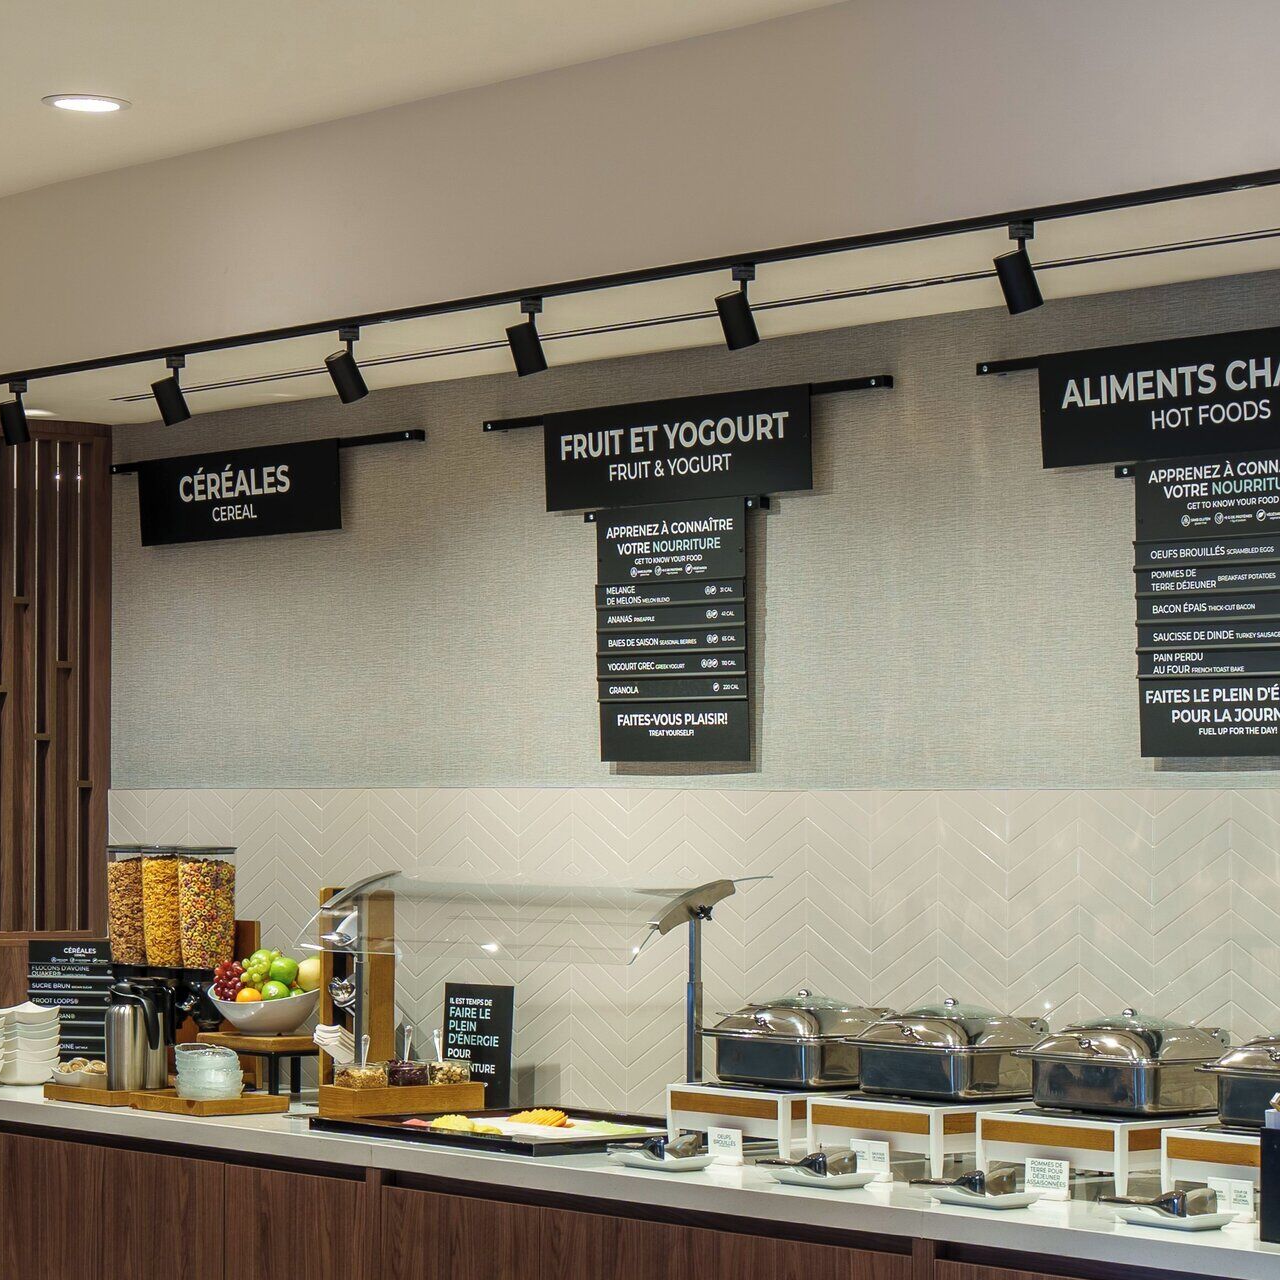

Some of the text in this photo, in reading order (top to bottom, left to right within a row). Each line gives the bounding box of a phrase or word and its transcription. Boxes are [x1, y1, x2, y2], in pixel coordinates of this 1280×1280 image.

[1061, 363, 1217, 409] ALIMENTS
[1151, 399, 1271, 430] HOT FOODS
[560, 411, 789, 461] FRUIT ET YOGOURT
[608, 453, 732, 482] FRUIT & YOGURT
[1148, 464, 1221, 484] APPRENEZ
[1223, 460, 1234, 477] À
[179, 464, 291, 502] CÉRÉALES
[1163, 482, 1208, 499] VOTRE
[1187, 495, 1279, 510] GET TO KNOW YOUR FOOD
[212, 504, 257, 522] CEREAL
[606, 516, 733, 539] APPRENEZ À CONNAÎTRE
[617, 537, 721, 556] VOTRE NOURRITURE
[1150, 545, 1274, 560] OEUFS BROUILLÉS SCRAMBLED EGGS
[653, 556, 670, 564] KNOW
[670, 555, 686, 563] YOUR
[686, 554, 702, 562] FOOD
[1151, 568, 1197, 579] POMMES DE
[1217, 572, 1276, 582] BREAKFAST POTATOES
[606, 585, 635, 595] MELANGE
[1151, 579, 1217, 592] TERRE DÉJEUNER
[606, 597, 616, 606] DE
[616, 595, 642, 605] MELONS
[1152, 601, 1255, 614] BACON ÉPAIS THICK-CUT BACON
[607, 615, 633, 624] ANANAS
[608, 639, 626, 648] BAIES
[626, 638, 636, 647] DE
[636, 637, 659, 647] SAISON
[1153, 631, 1193, 642] SAUCISSE
[1193, 631, 1205, 641] DE
[1207, 630, 1235, 640] DINDE
[1153, 652, 1203, 662] PAIN PERDU
[607, 662, 637, 671] YOGOURT
[637, 661, 655, 670] GREC
[1153, 665, 1166, 674] AU
[1166, 664, 1190, 674] FOUR
[608, 686, 639, 694] GRANOLA
[1145, 689, 1190, 704] FAITES
[1193, 689, 1209, 703] LE
[1213, 687, 1254, 702] PLEIN
[617, 712, 728, 726] FAITES-VOUS PLAISIR!
[1171, 709, 1211, 723] POUR
[1214, 709, 1232, 722] LA
[648, 729, 666, 737] TREAT
[1218, 727, 1228, 735] UP
[1229, 727, 1245, 735] FOR
[1260, 726, 1277, 734] DAY!
[465, 998, 484, 1006] TEMPS
[449, 1007, 491, 1020] FAIRE LE
[448, 1020, 477, 1032] PLEIN
[448, 1032, 499, 1047] D'ÉNERGIE
[447, 1048, 471, 1058] POUR
[1030, 1160, 1054, 1168] POMMES
